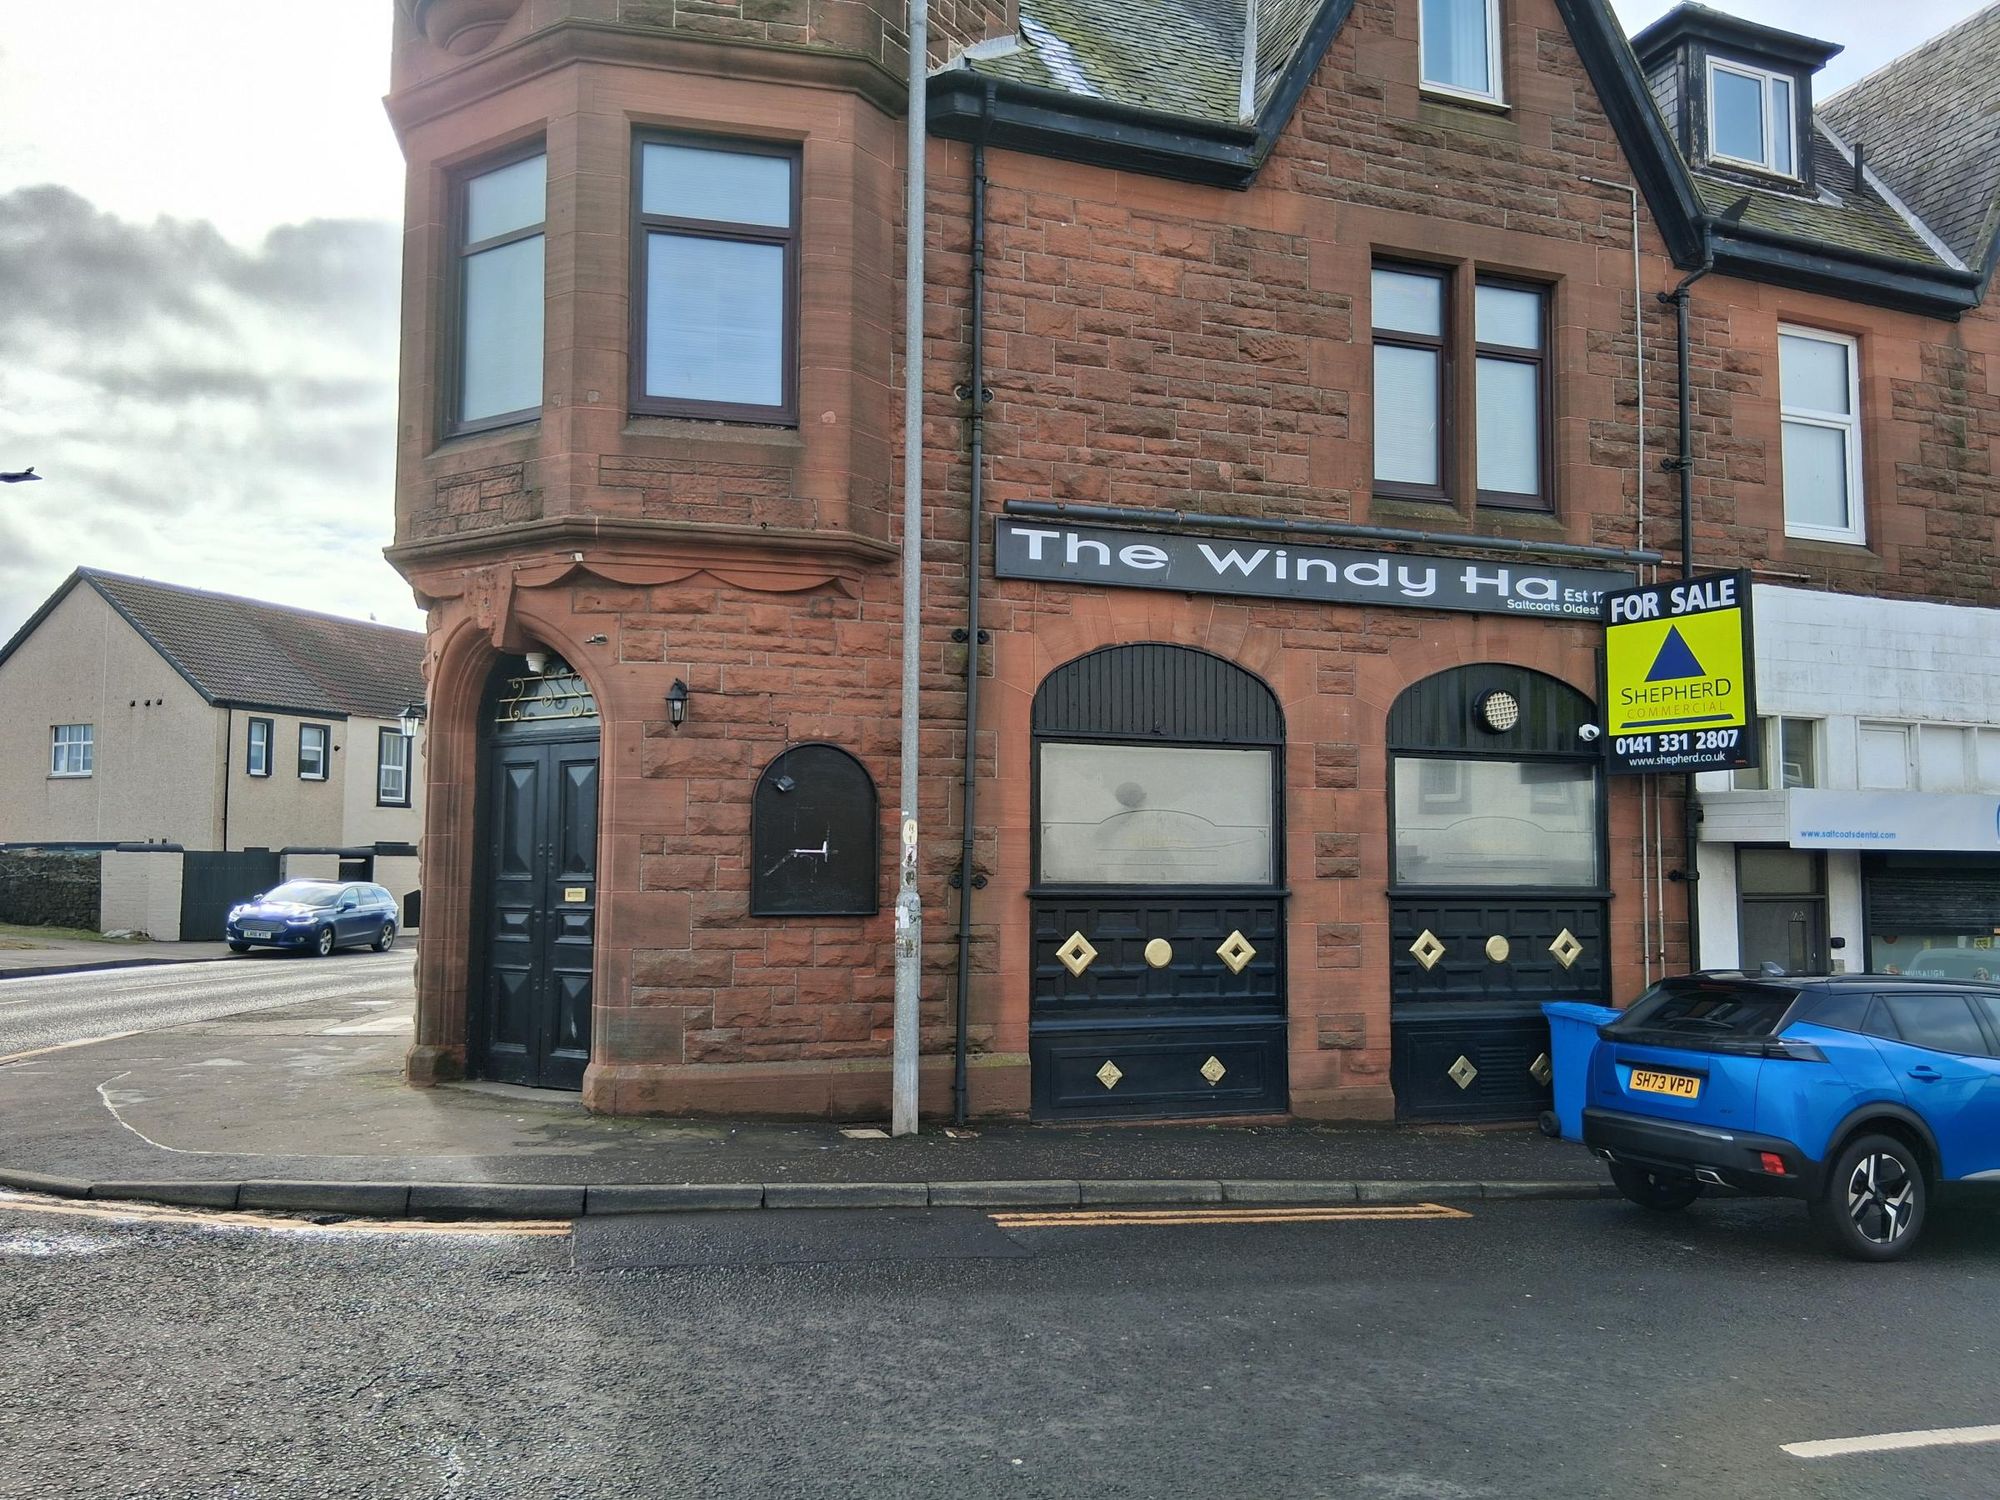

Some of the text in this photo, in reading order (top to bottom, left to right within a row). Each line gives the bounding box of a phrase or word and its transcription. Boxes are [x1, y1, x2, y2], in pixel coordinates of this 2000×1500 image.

[1011, 528, 1557, 600] The Windy Ha
[1564, 588, 1588, 603] Est
[1611, 578, 1736, 623] FOR SALE
[1507, 599, 1599, 615] Saltcoats Oldest
[1621, 678, 1732, 706] SHEPHERD
[1627, 701, 1726, 719] COMMERCIAL
[1615, 729, 1739, 755] 0141 331 2807
[1628, 751, 1726, 767] www.shepherd.co.uk
[1800, 829, 1897, 840] www.saltcoatsdental.com
[1635, 1072, 1694, 1094] SH73 VPD
